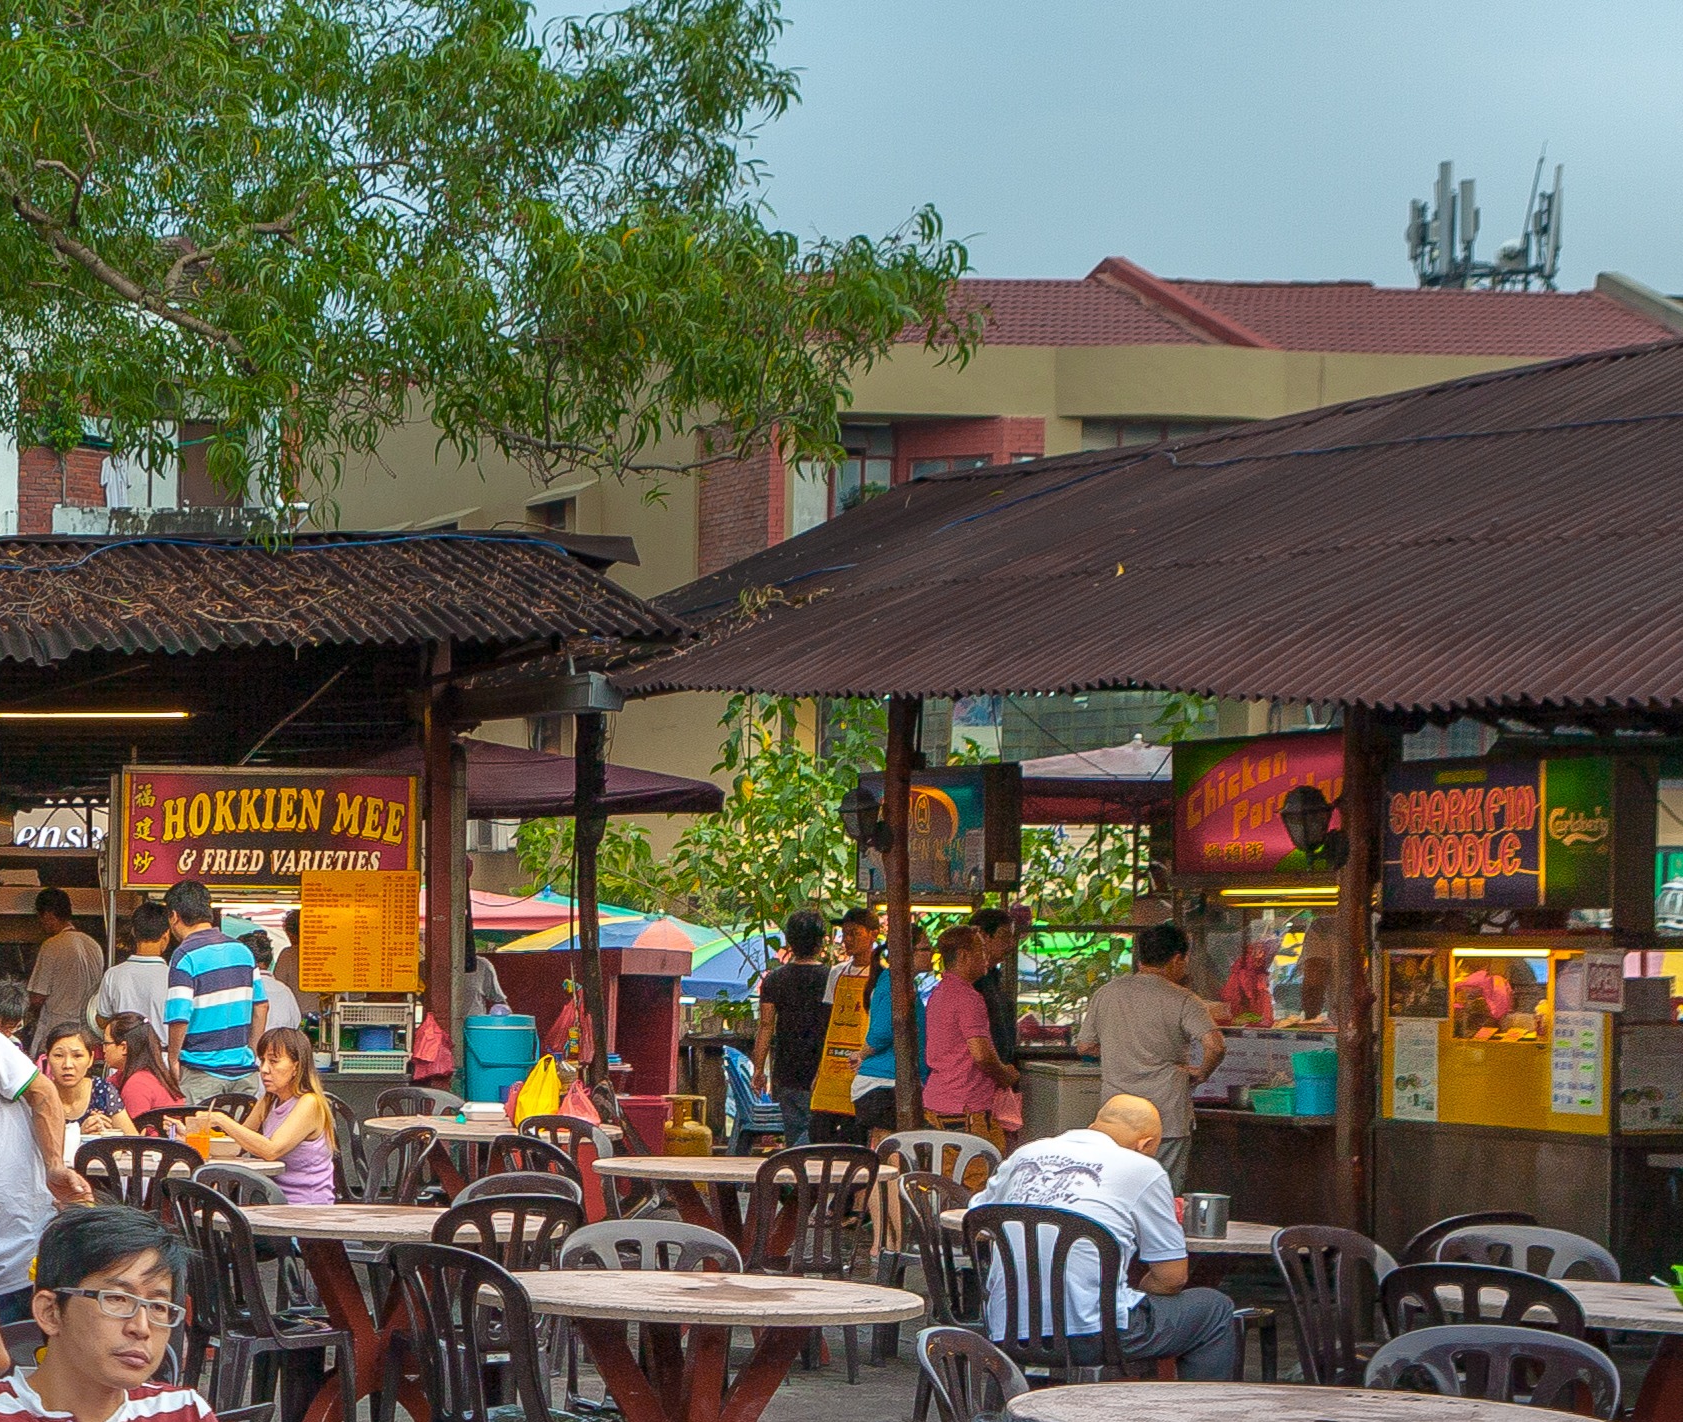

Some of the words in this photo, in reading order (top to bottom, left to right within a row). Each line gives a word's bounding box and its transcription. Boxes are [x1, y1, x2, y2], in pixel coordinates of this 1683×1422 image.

[1186, 751, 1288, 831] Chicken
[161, 787, 323, 844] HOKKIEN
[334, 791, 406, 846] MEE
[1548, 806, 1609, 842] Carlsberg
[179, 849, 196, 874] &
[200, 849, 264, 875] FRIED
[271, 849, 381, 873] VARIETIES
[1401, 832, 1522, 878] NOODLE
